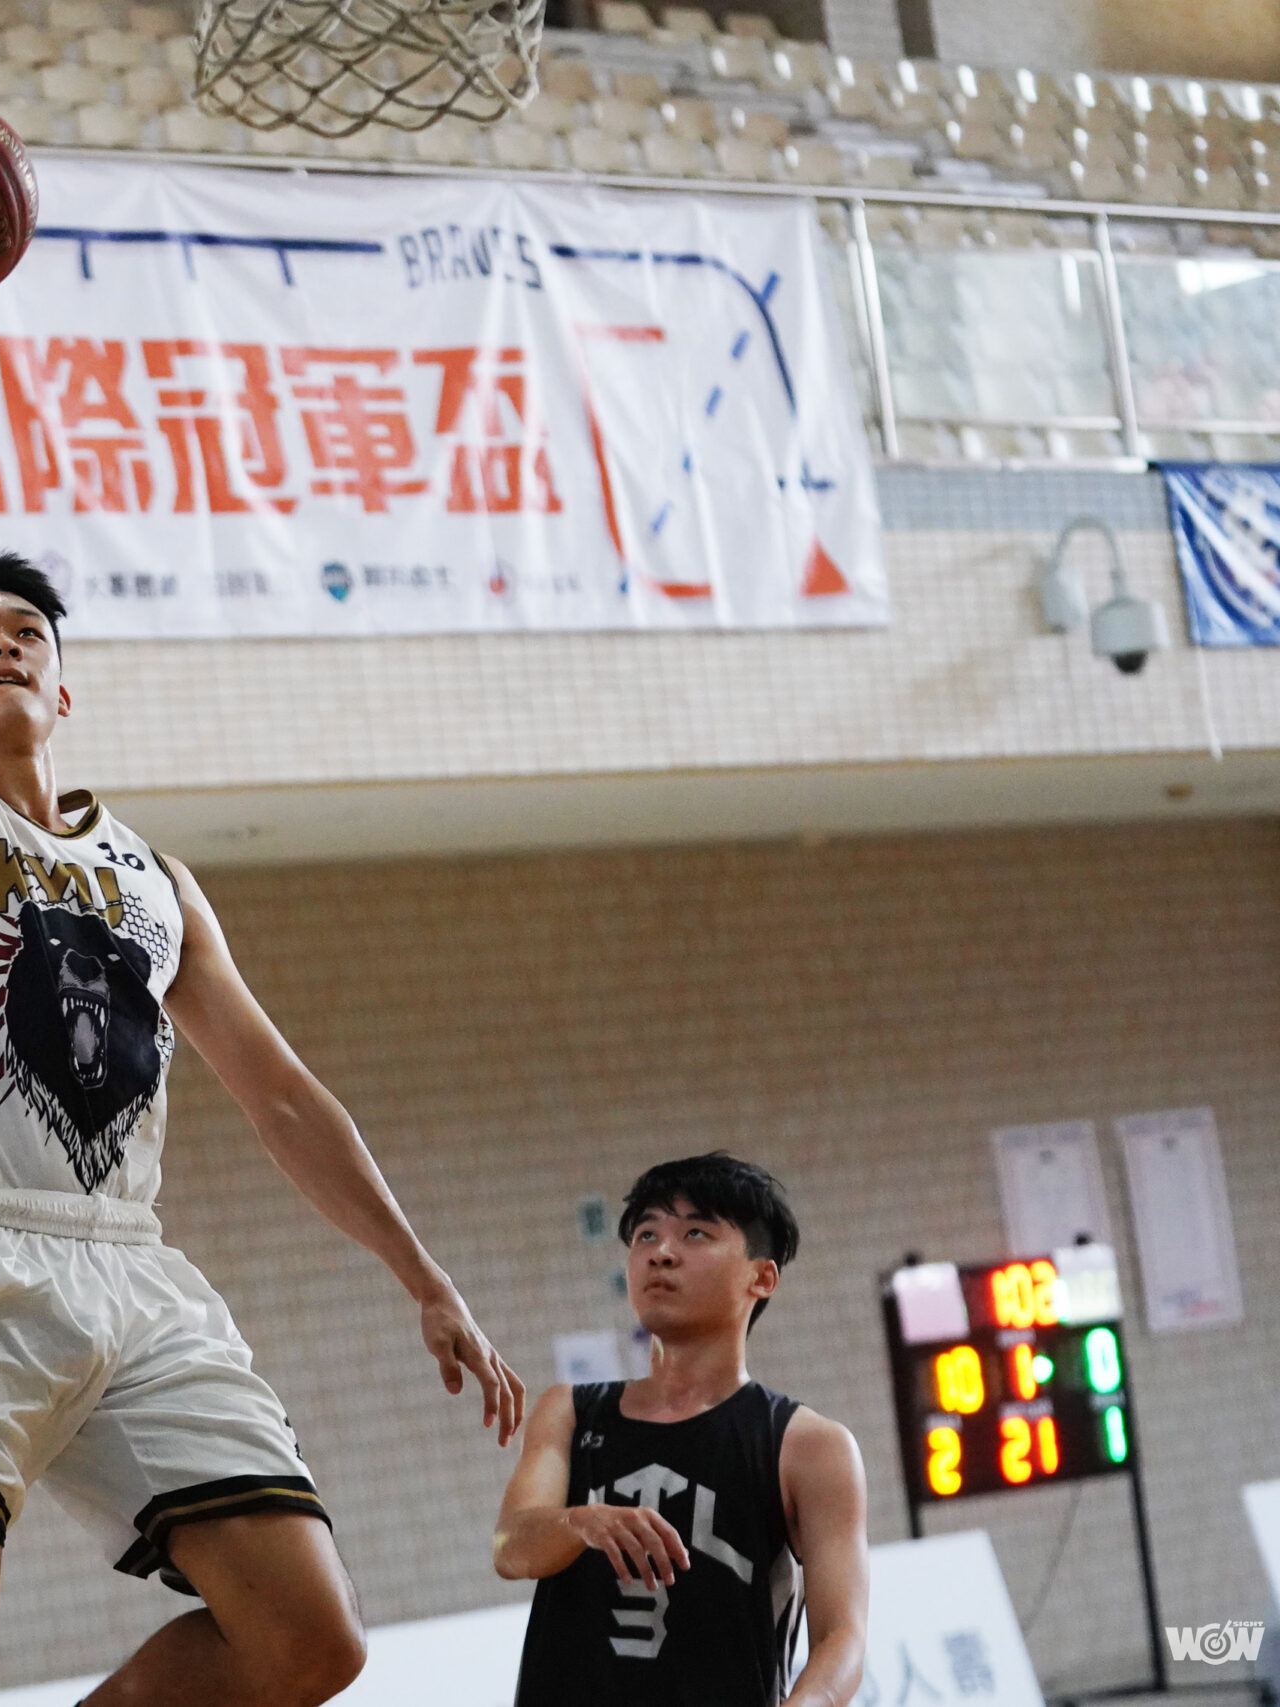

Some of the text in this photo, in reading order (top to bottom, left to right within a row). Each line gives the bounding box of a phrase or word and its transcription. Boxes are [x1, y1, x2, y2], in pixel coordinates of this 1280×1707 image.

[1083, 1326, 1121, 1394] 0
[1104, 1405, 1129, 1464] 1
[587, 1456, 754, 1585] TL
